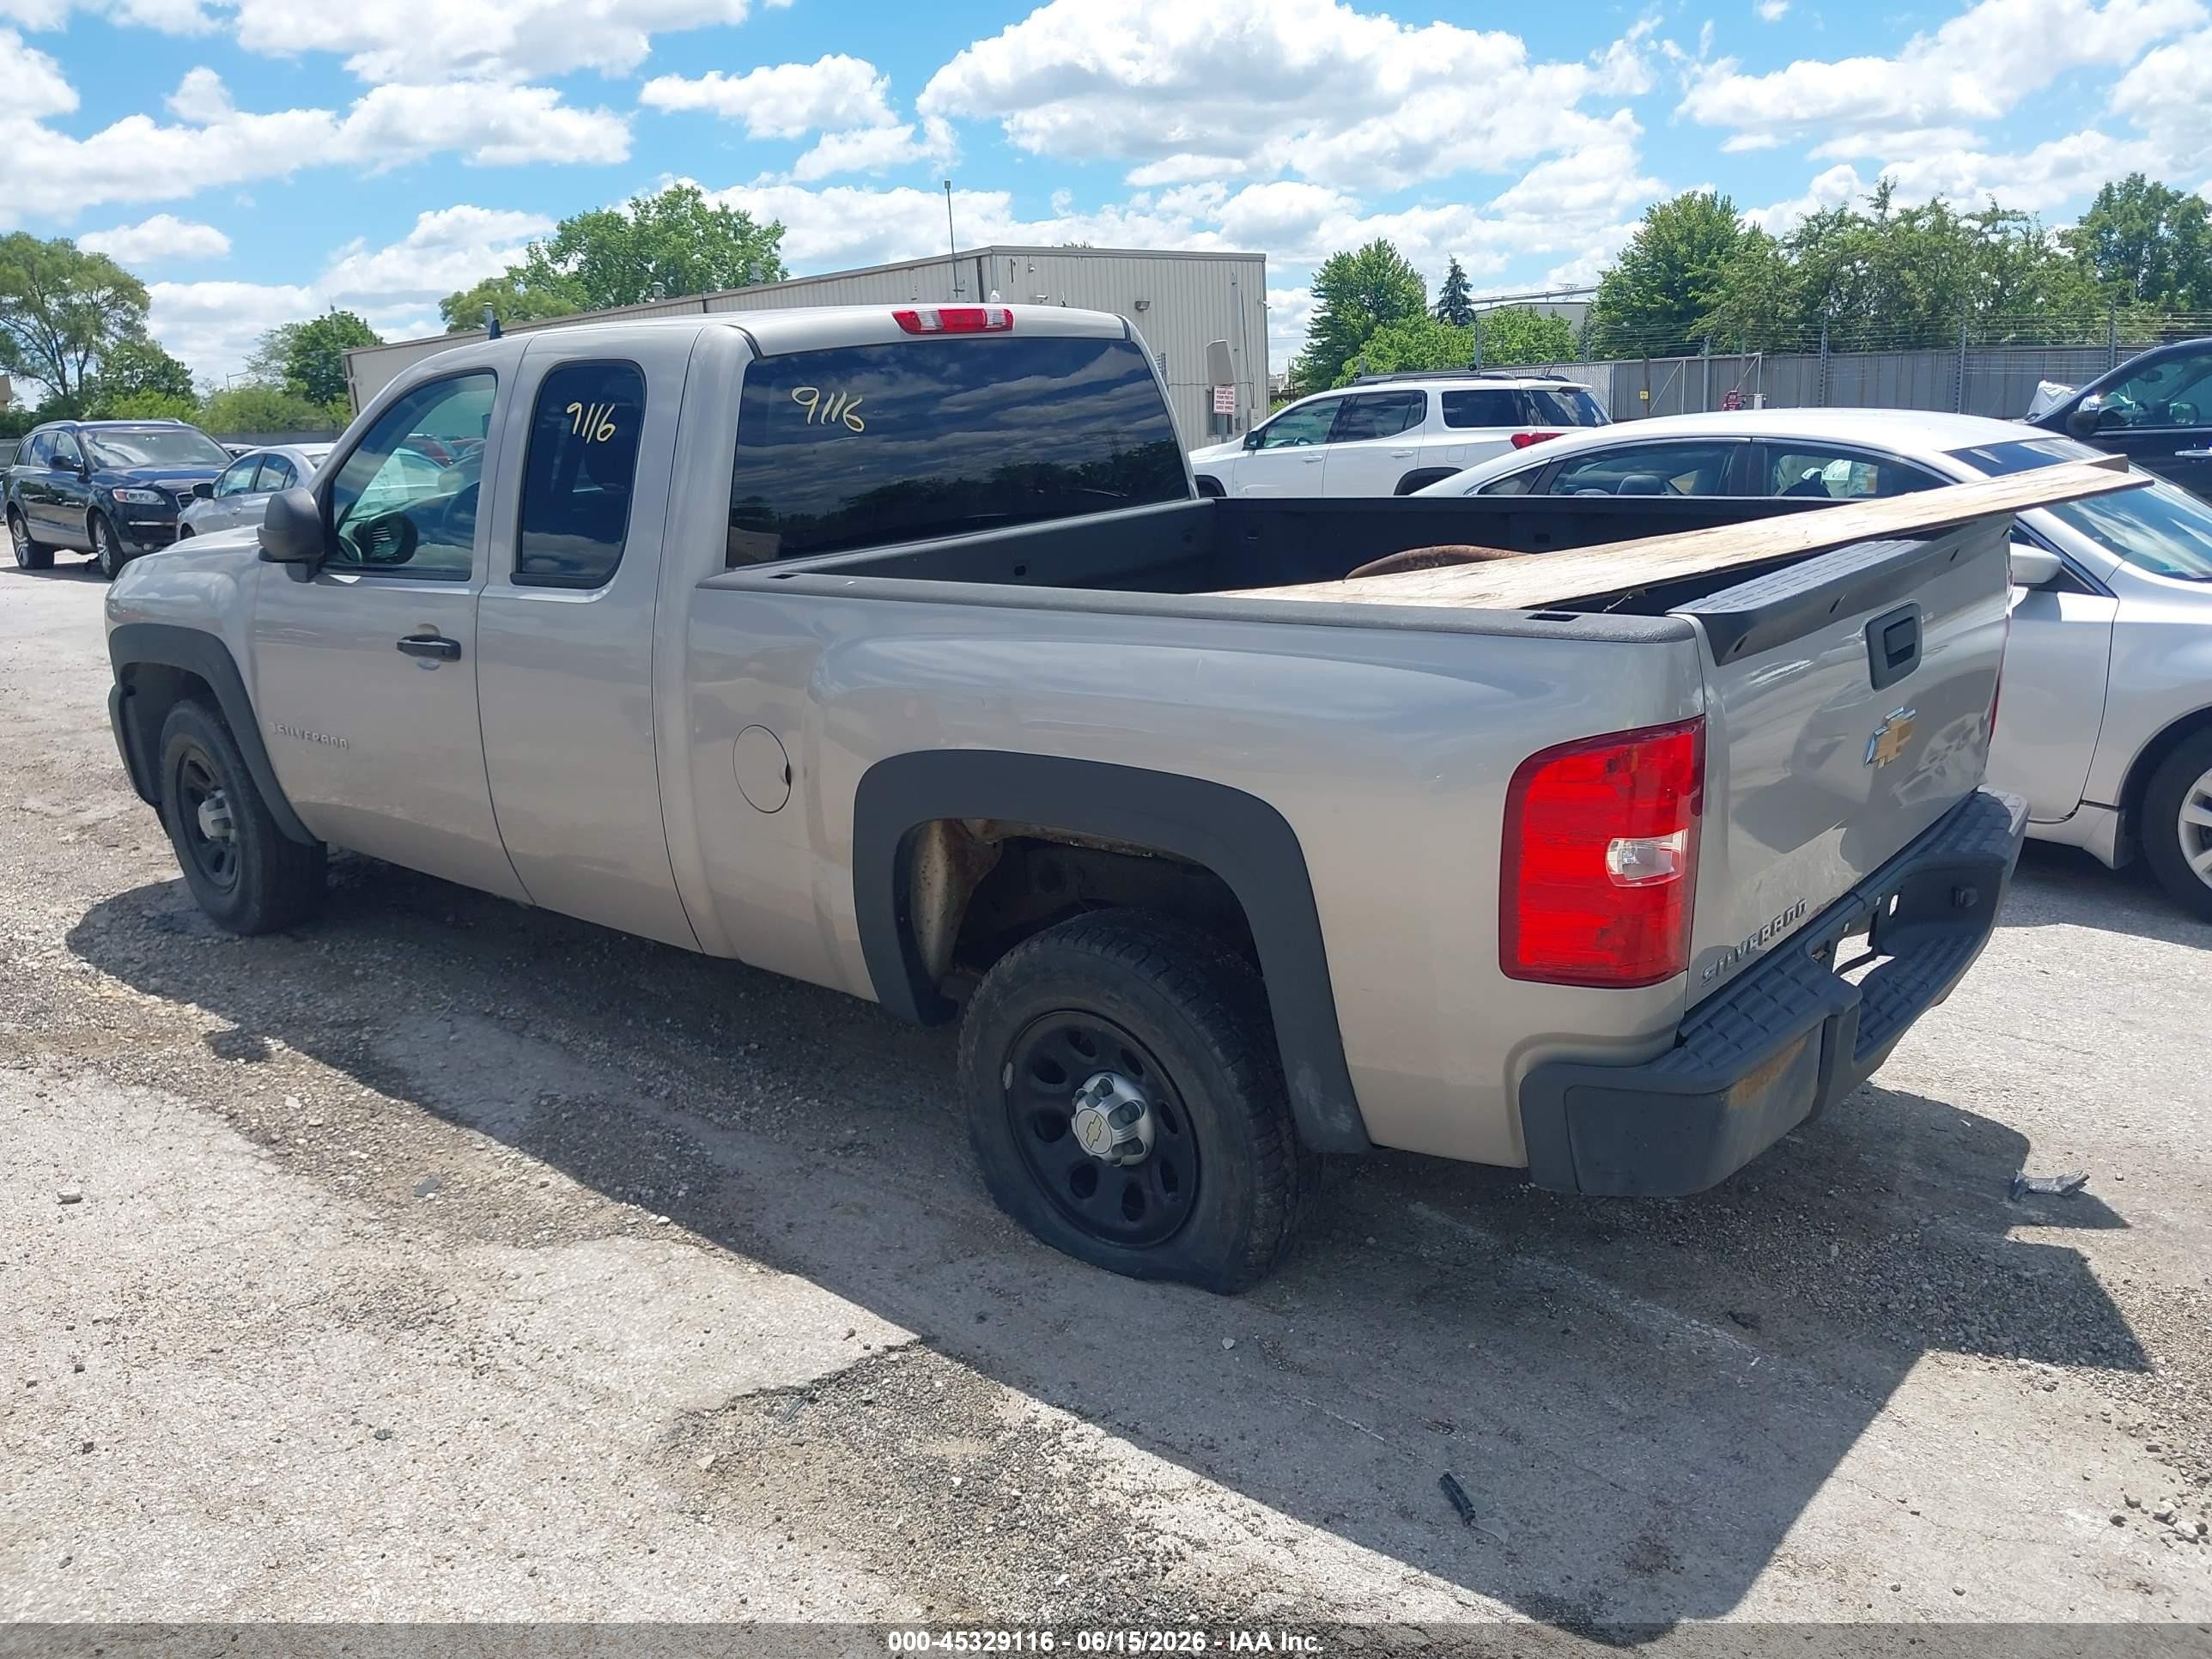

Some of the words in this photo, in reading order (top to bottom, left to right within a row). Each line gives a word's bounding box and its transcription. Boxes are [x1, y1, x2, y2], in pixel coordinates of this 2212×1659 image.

[566, 401, 617, 444] 9116
[791, 386, 865, 432] 9116
[276, 723, 350, 750] SILVERADO
[1701, 898, 1808, 985] SILVERADO
